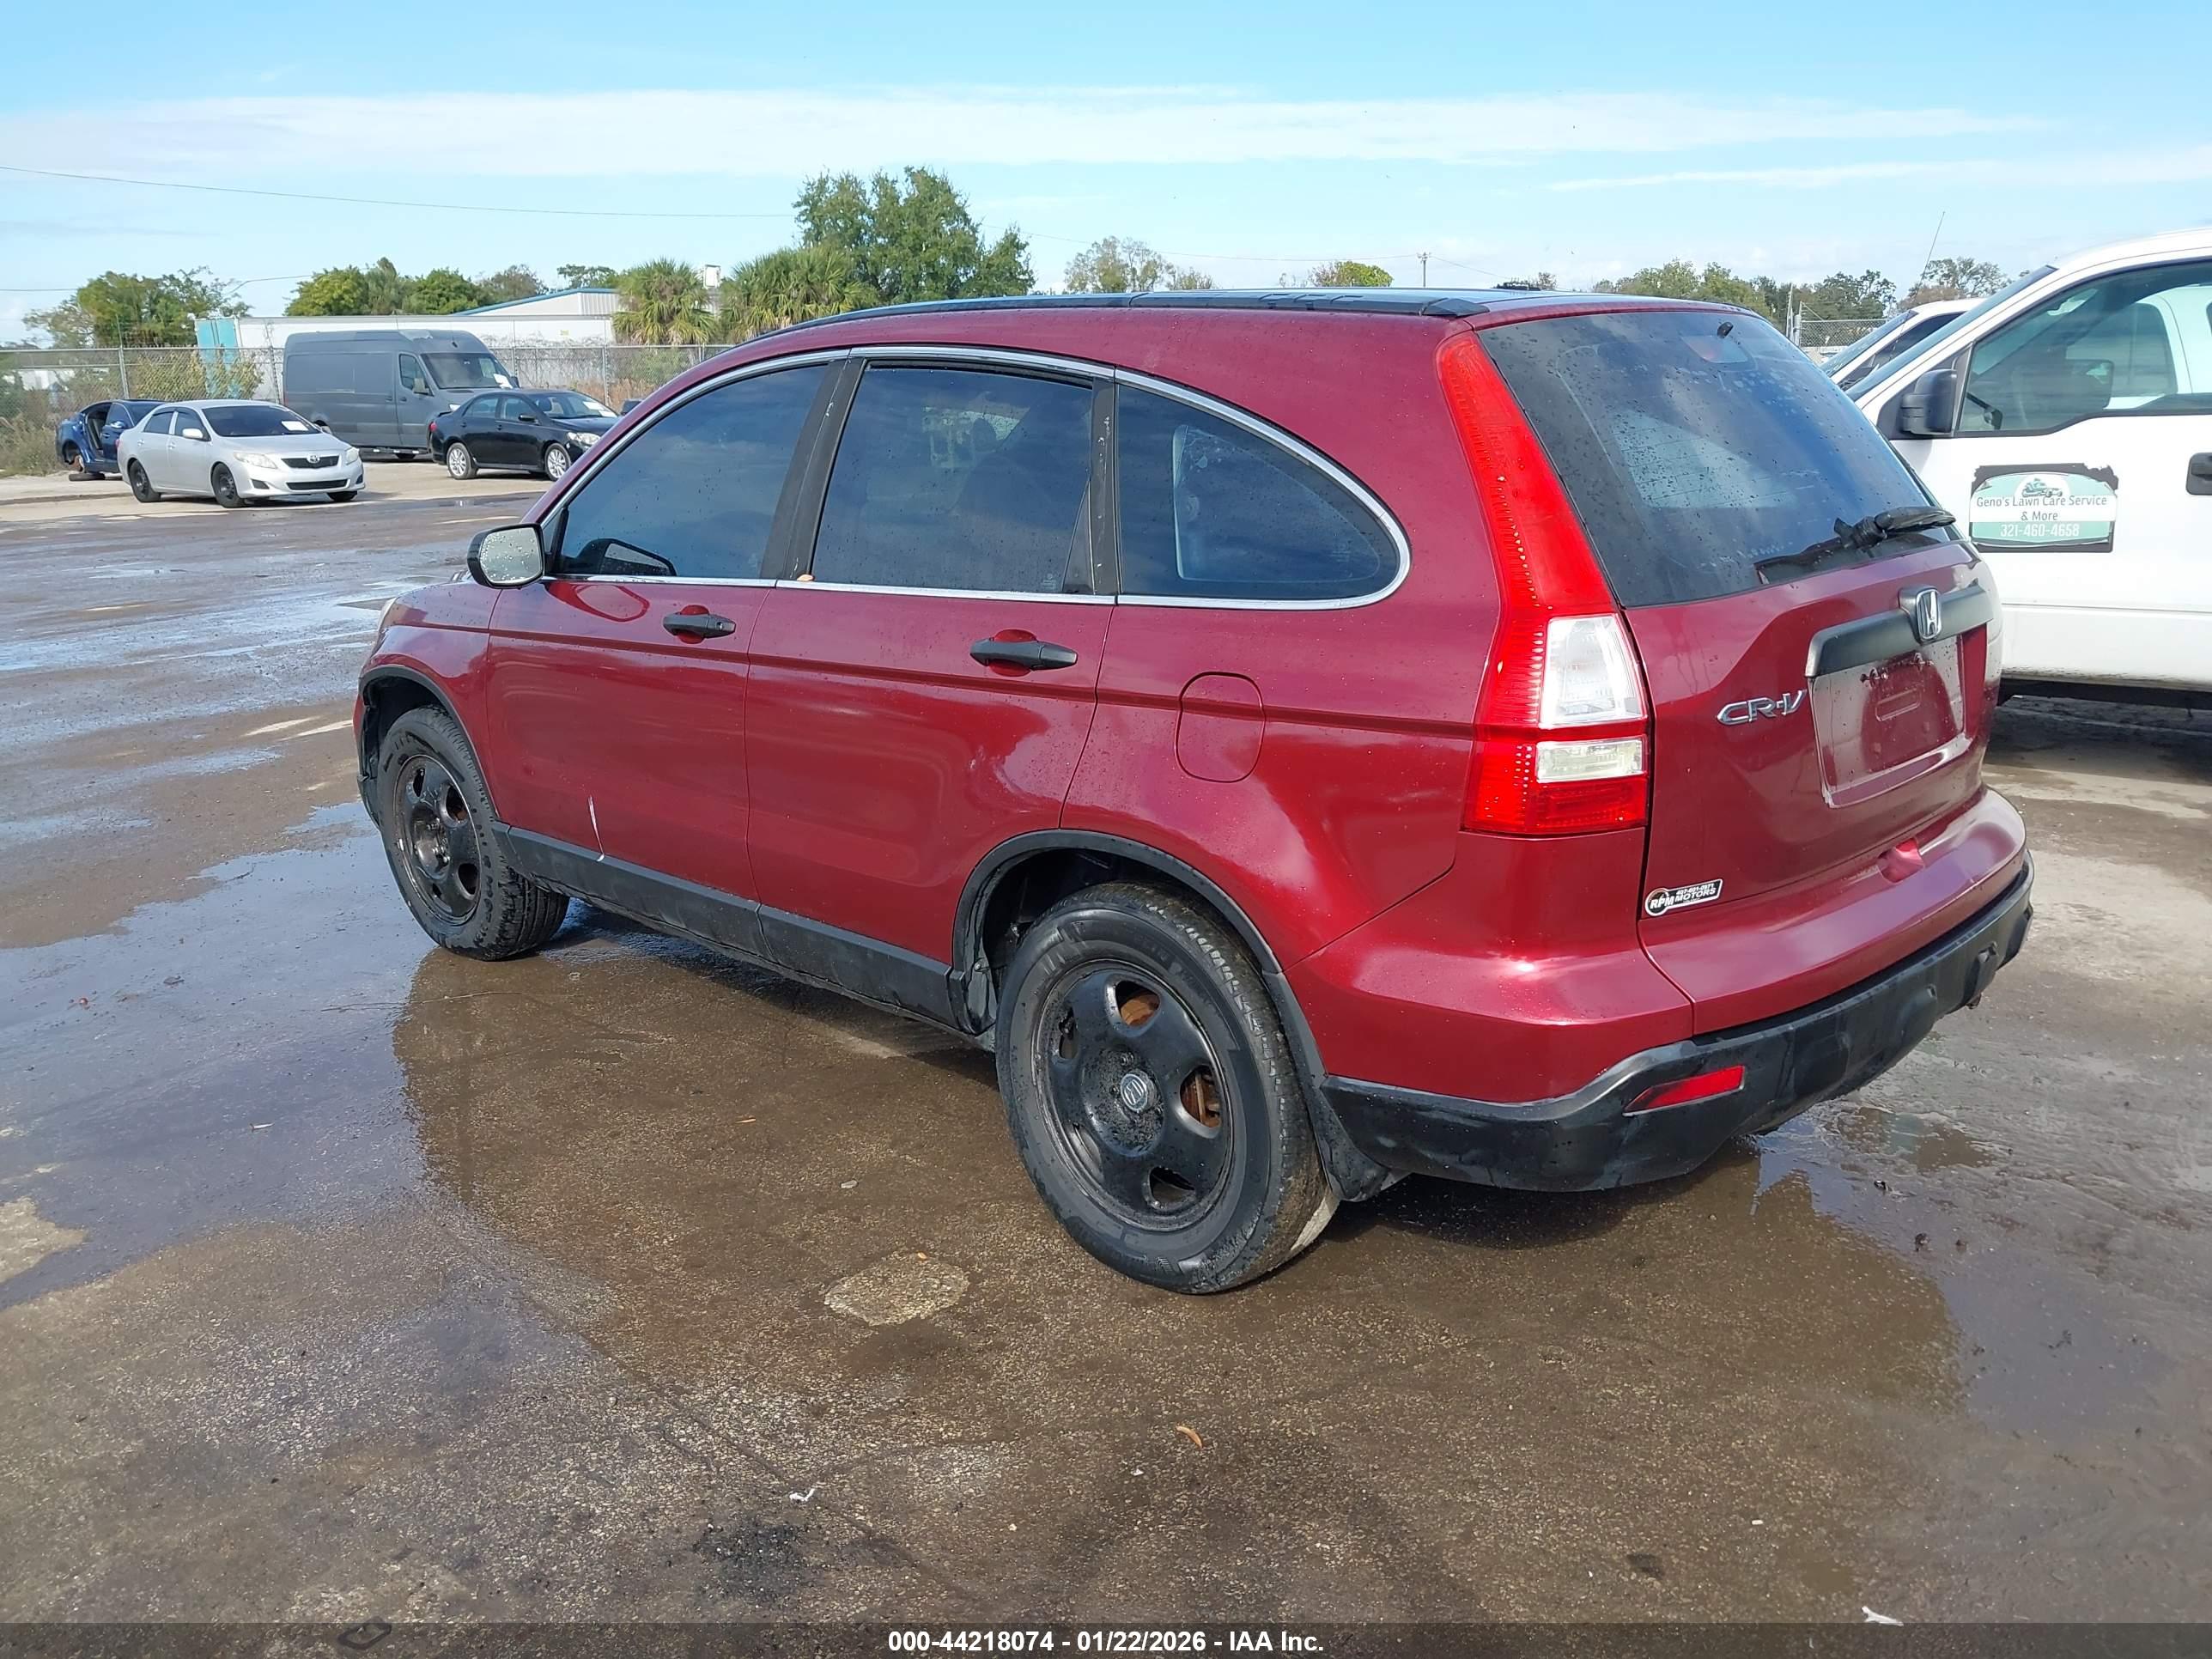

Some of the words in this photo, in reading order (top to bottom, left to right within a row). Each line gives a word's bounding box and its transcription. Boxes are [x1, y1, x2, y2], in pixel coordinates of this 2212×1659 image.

[1976, 496, 2010, 507] Geno's
[2012, 495, 2039, 507] Lawn
[2042, 495, 2066, 506] Care
[2069, 494, 2107, 506] Service
[2021, 511, 2029, 521] &
[2032, 511, 2058, 521] More
[2000, 523, 2080, 538] 321-460-4658
[1717, 690, 1806, 726] CR-V
[1650, 896, 1674, 909] RPM
[1674, 887, 1717, 902] MOTORS
